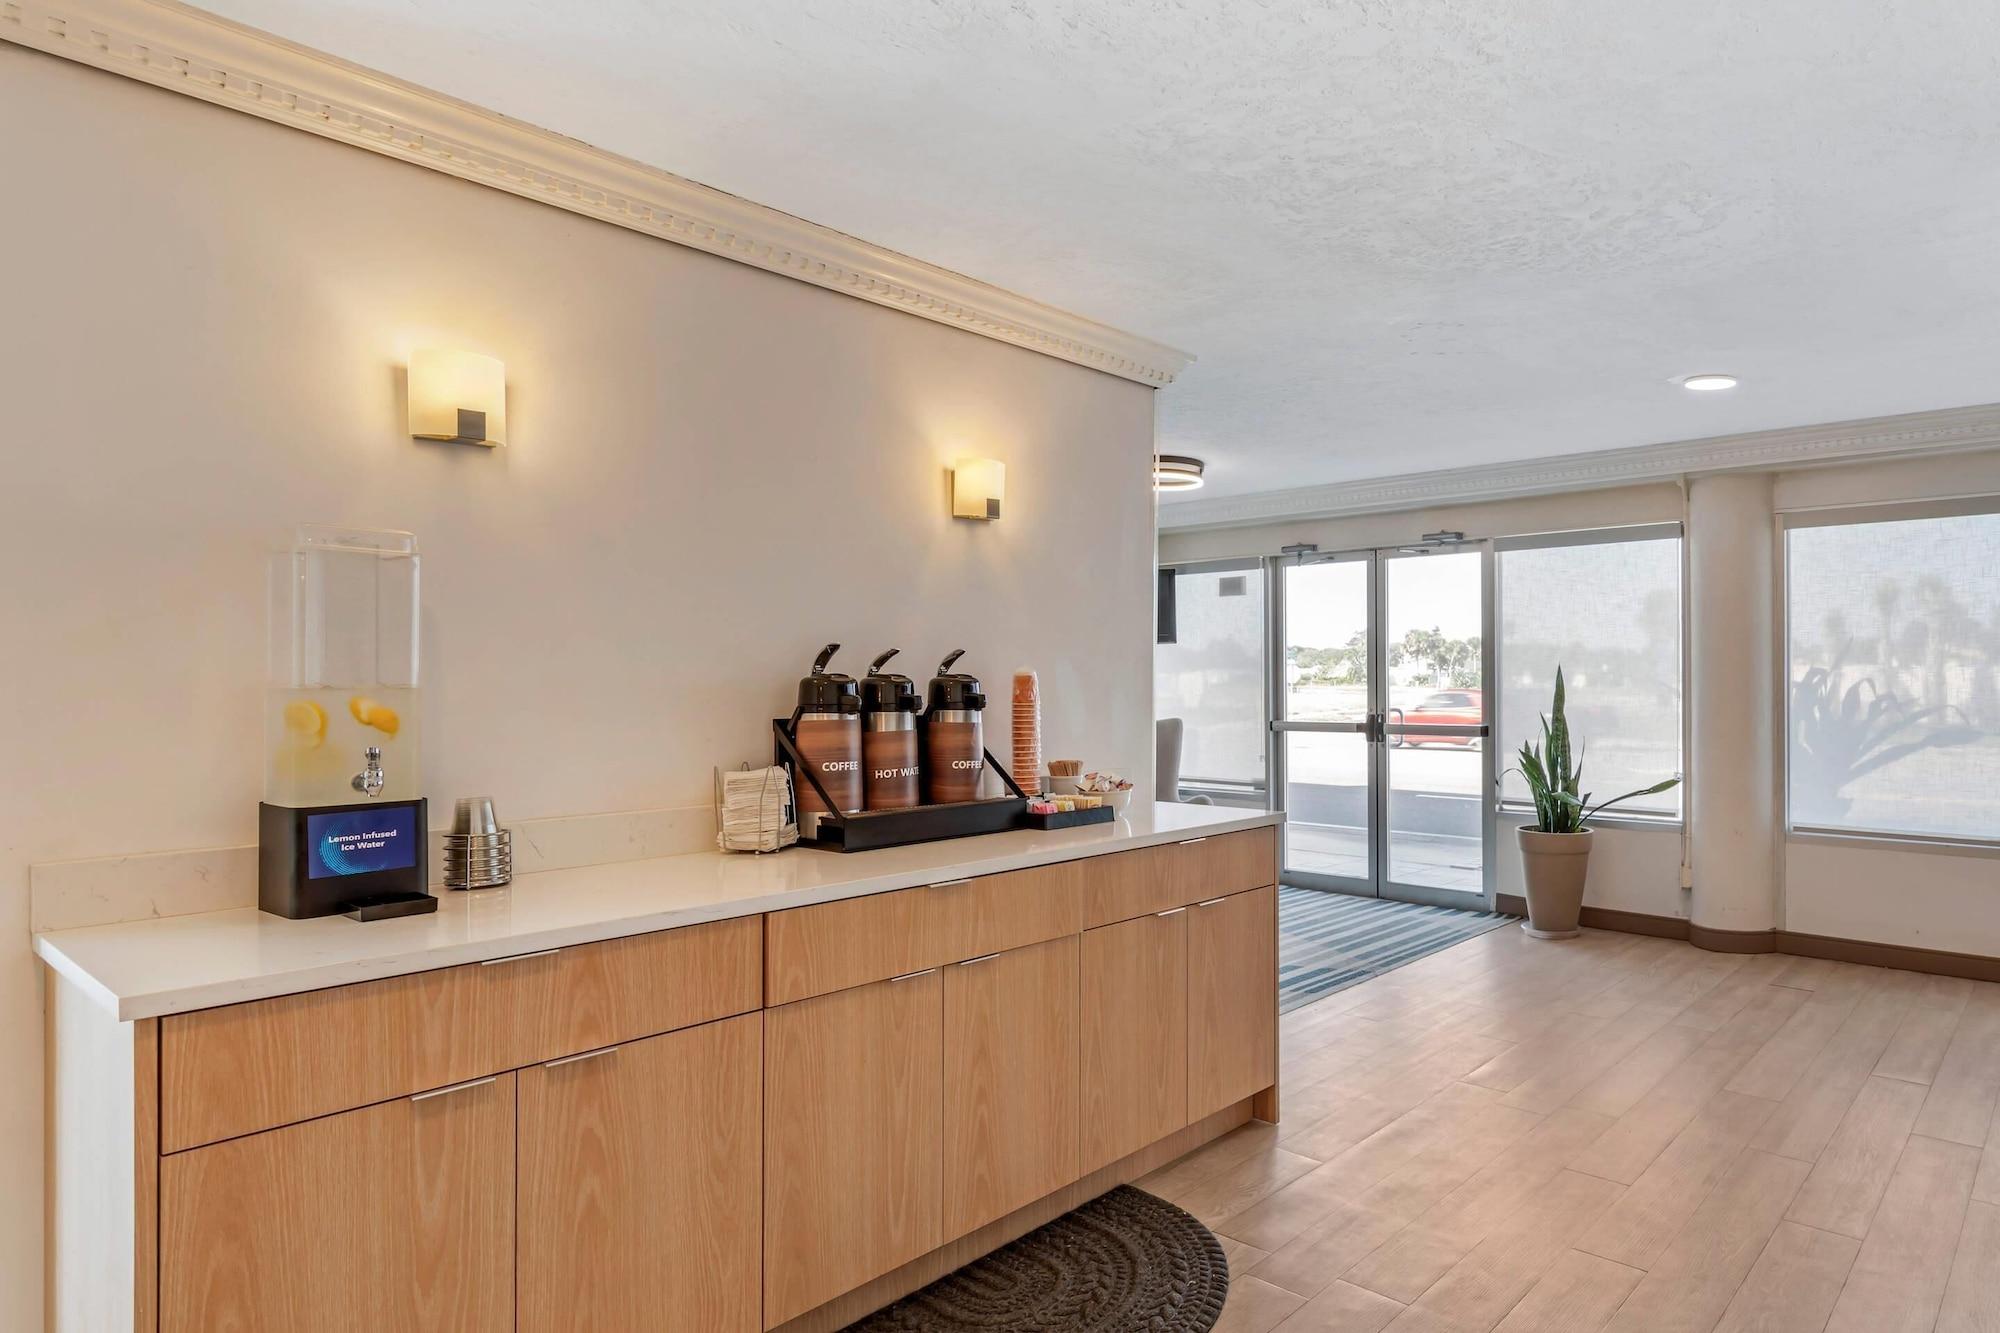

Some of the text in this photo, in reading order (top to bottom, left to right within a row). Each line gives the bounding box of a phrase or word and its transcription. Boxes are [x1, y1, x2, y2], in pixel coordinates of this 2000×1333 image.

[822, 761, 858, 772] COFFEE
[952, 760, 982, 769] COFFEE
[875, 768, 898, 779] HOT
[328, 829, 397, 843] Lemon Infused
[357, 841, 385, 849] Water
